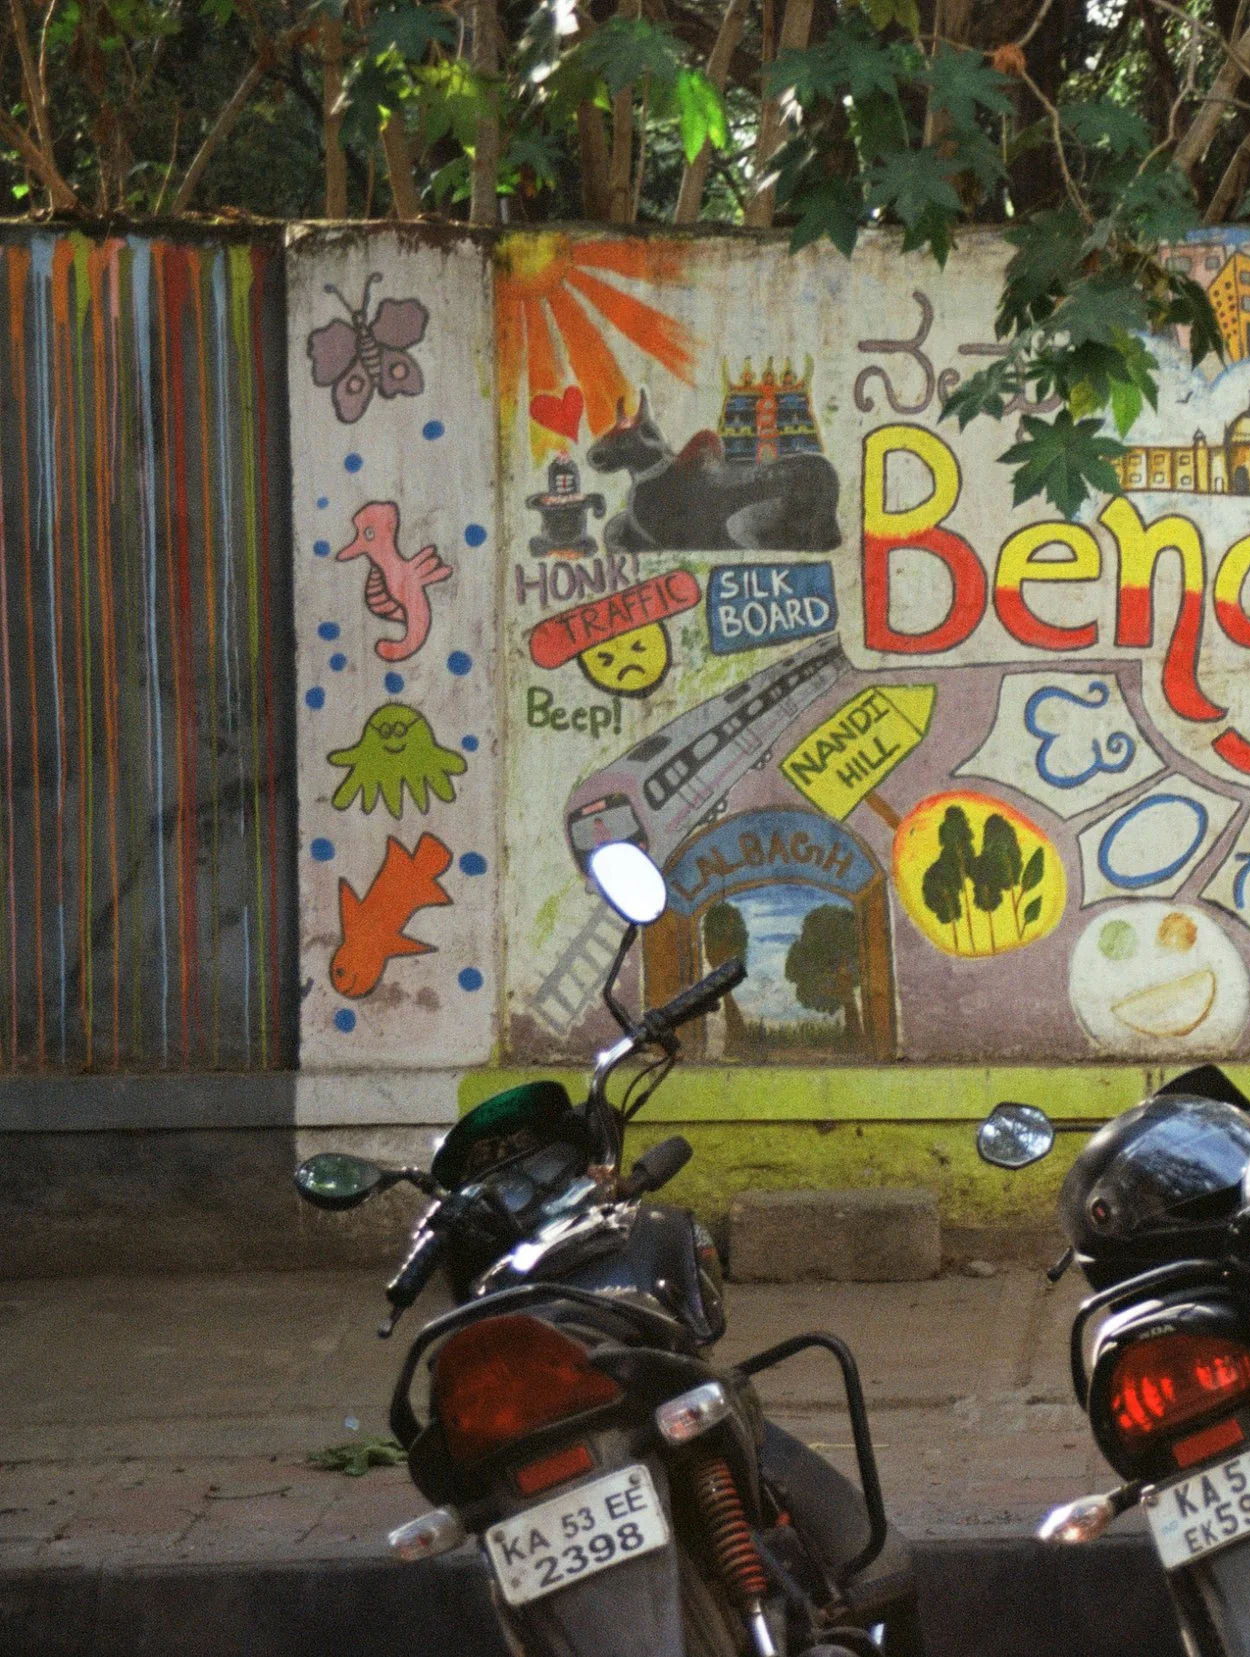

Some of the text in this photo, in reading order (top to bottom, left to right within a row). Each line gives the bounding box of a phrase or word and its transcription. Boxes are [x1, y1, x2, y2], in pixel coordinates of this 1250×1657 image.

[514, 554, 641, 607] HONK!
[556, 572, 688, 644] TRAFFIC
[720, 568, 793, 599] SILK
[719, 596, 830, 638] BOARD
[526, 686, 623, 737] Beep!
[789, 693, 890, 786] NANDI
[836, 736, 901, 789] HILL
[670, 830, 855, 904] LALBAGH
[499, 1485, 649, 1565] KA 53 EE
[534, 1521, 645, 1588] 2398
